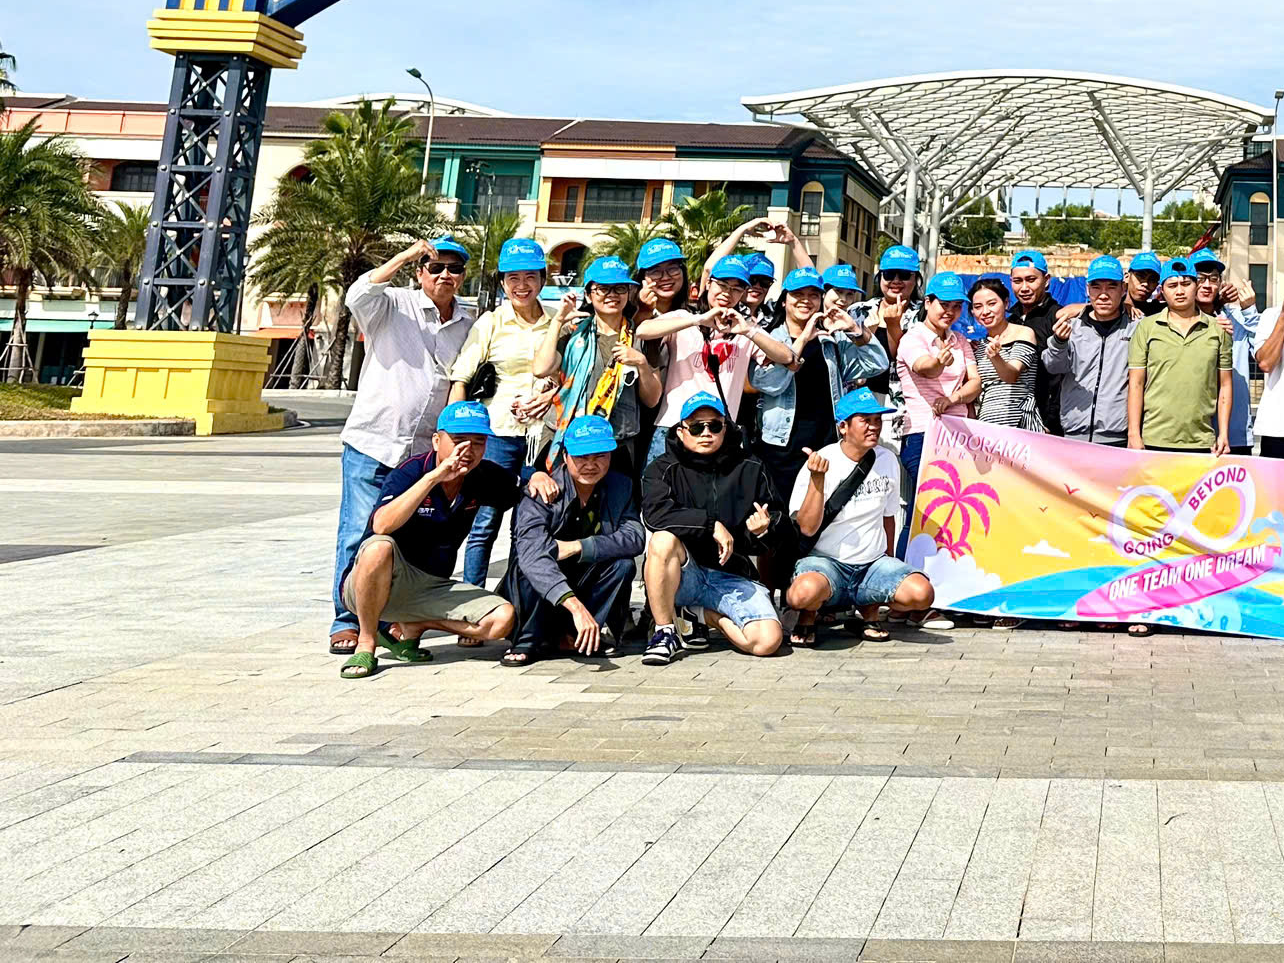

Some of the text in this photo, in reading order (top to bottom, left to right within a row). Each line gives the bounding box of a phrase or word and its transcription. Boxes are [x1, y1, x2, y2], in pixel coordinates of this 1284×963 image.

[936, 426, 1032, 461] INDORAMA
[1188, 467, 1247, 511] BEYOND
[1123, 533, 1174, 555] GOING
[1109, 543, 1267, 601] ONE TEAM ONE DREAM
